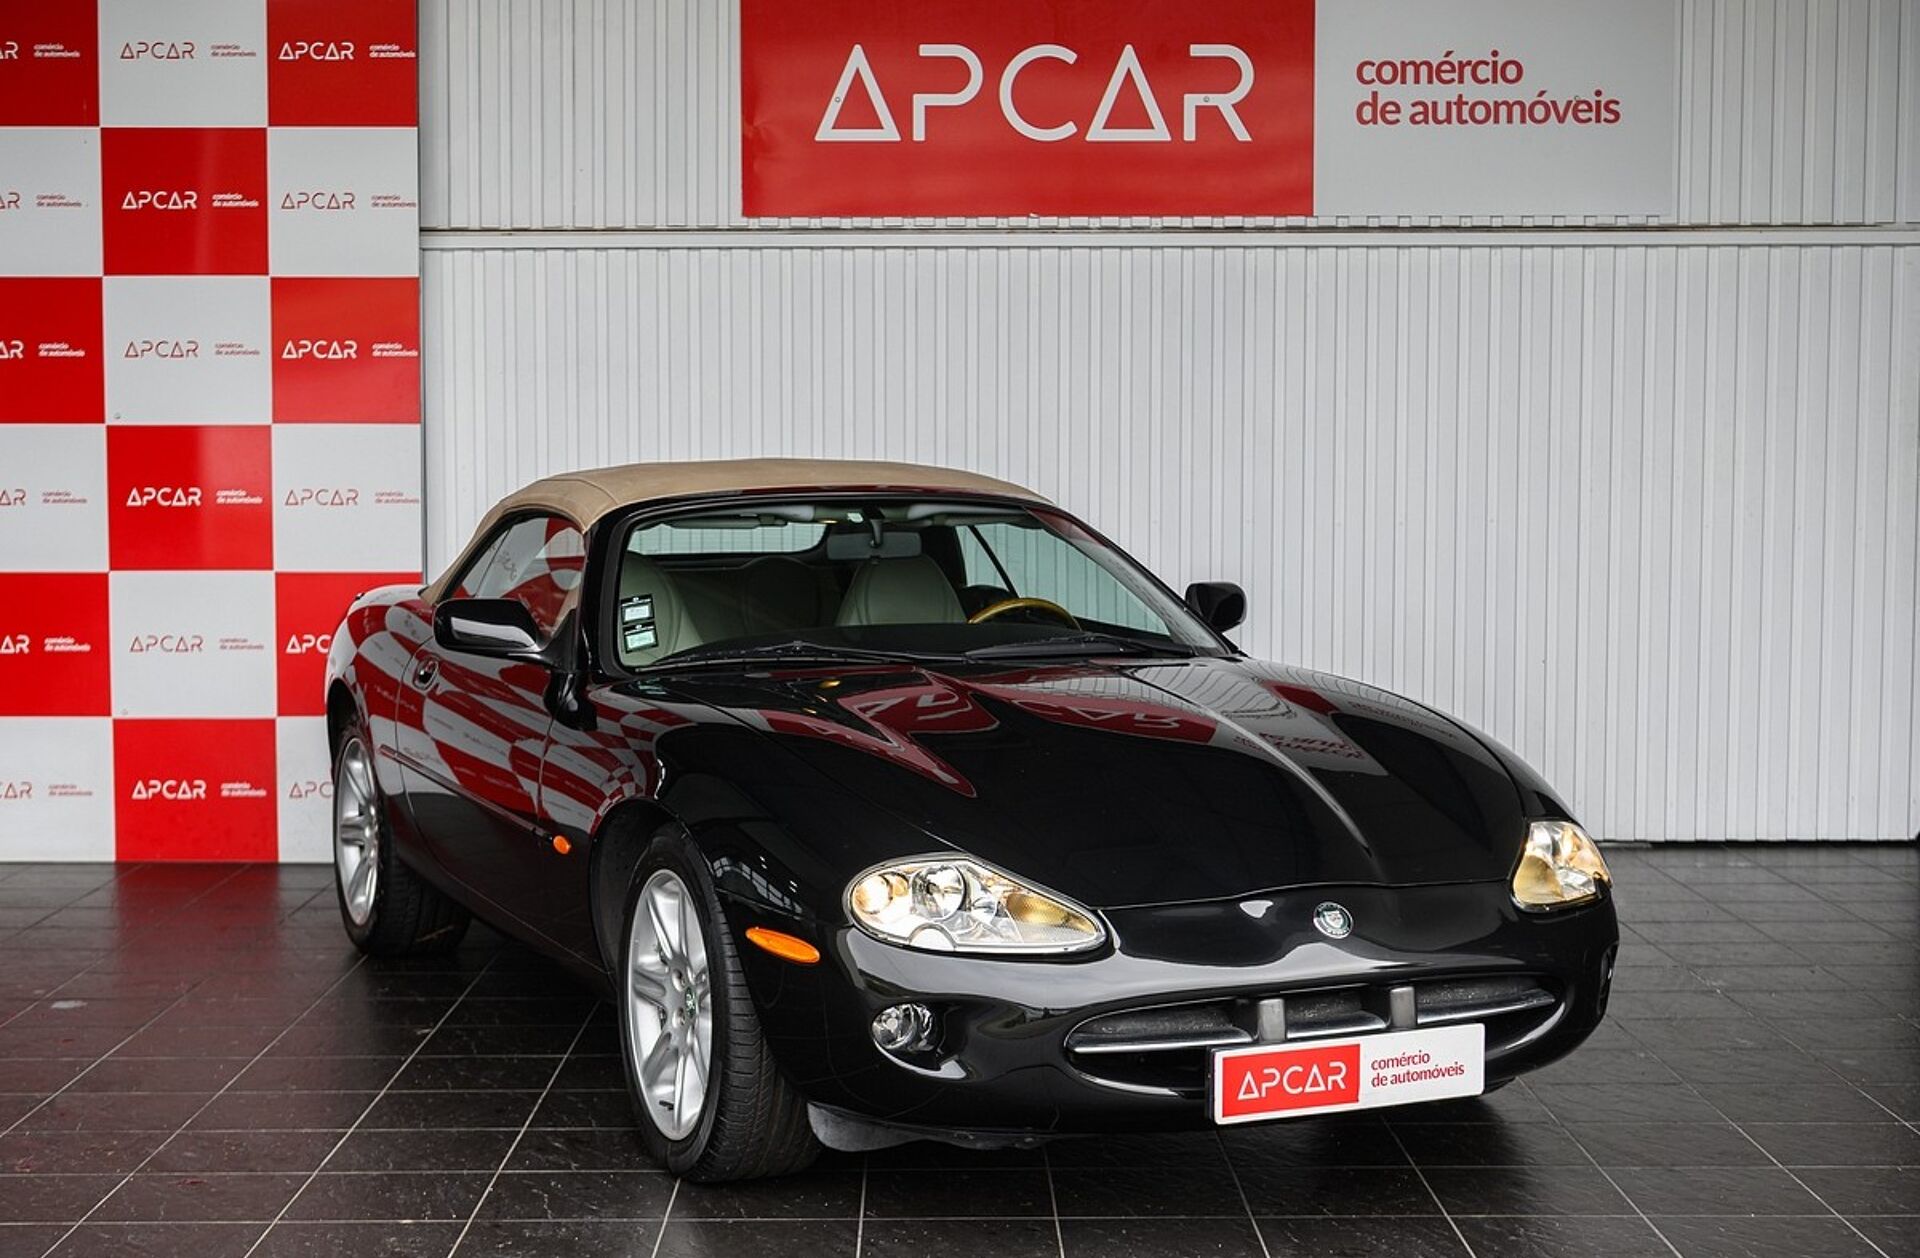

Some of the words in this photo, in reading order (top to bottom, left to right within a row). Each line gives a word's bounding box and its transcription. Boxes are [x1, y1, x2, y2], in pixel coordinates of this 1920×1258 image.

[0, 42, 18, 59] R
[121, 41, 195, 60] APCAR
[279, 42, 355, 60] APCAR
[1356, 50, 1523, 85] comércio
[815, 43, 1254, 142] APCAR
[1356, 91, 1400, 125] de
[1409, 88, 1620, 126] automóveis
[122, 191, 197, 210] APCAR
[281, 192, 356, 210] APCAR
[0, 340, 24, 359] AR
[125, 341, 199, 359] APCAR
[281, 340, 357, 359] APCAR
[0, 488, 26, 506] AR
[126, 488, 202, 507] APCAR
[284, 488, 359, 506] APCAR
[0, 634, 30, 654] AR
[130, 634, 204, 653] APCAR
[286, 634, 331, 654] APC
[0, 781, 32, 799] AR
[131, 780, 206, 800] APCAR
[289, 781, 333, 798] APC
[1371, 1050, 1430, 1071] comércio
[1237, 1061, 1347, 1100] APCAR
[1372, 1072, 1388, 1087] de
[1391, 1061, 1465, 1086] automóveis
